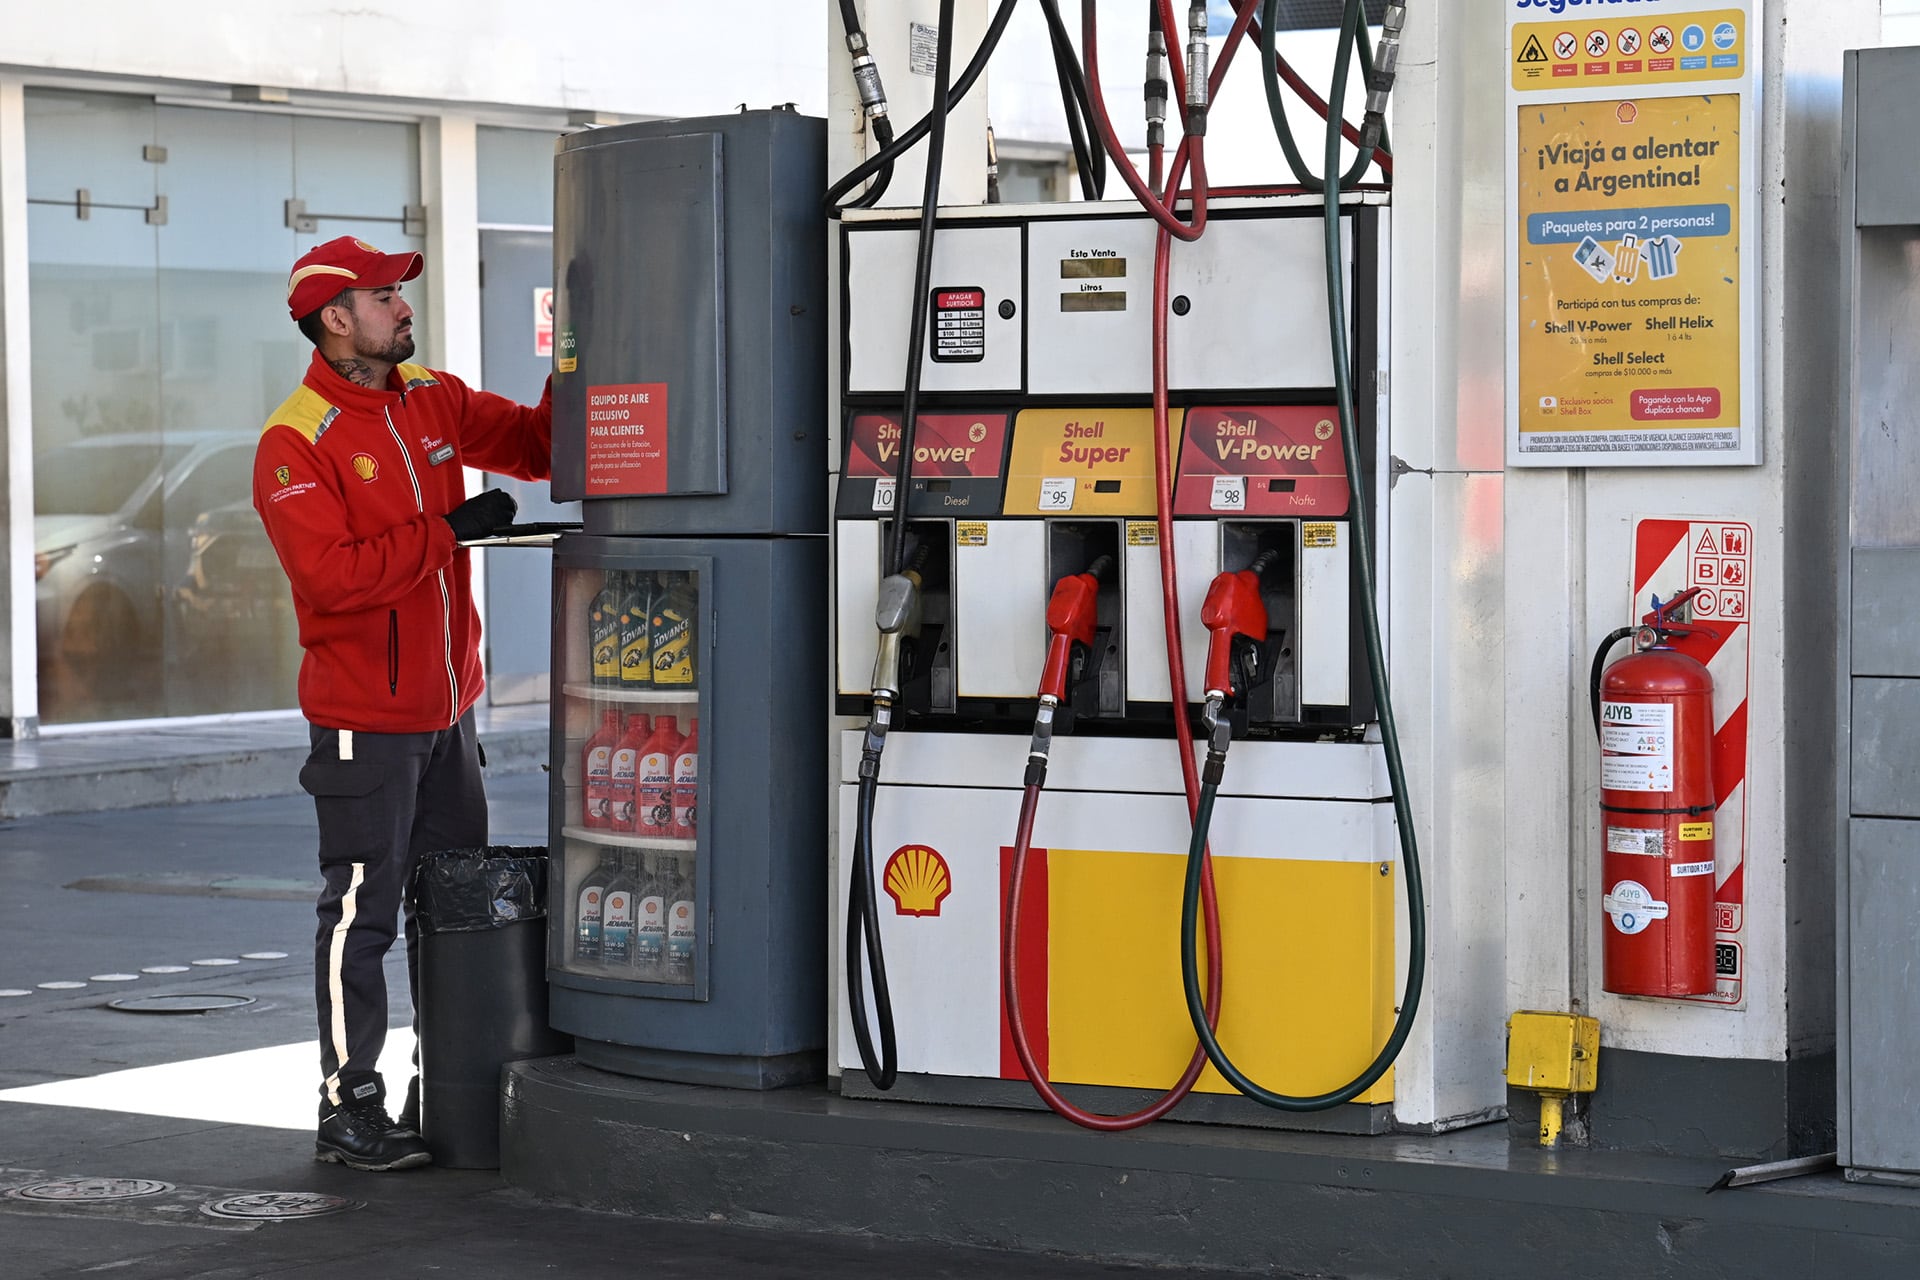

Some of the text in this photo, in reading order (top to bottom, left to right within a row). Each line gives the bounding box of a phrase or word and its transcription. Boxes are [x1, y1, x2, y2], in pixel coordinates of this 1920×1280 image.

[1538, 137, 1720, 170] ¡Viajá a alentar
[1554, 164, 1700, 196] a Argentina!
[1542, 213, 1715, 238] ¡Paquetes para 2 personas!
[1071, 249, 1116, 258] Esta Venta
[1080, 283, 1102, 291] Litros
[1557, 294, 1701, 311] Participá con tus compras de:
[1545, 320, 1632, 334] Shell V-Power
[1645, 316, 1714, 330] Shell Helix
[1593, 352, 1665, 365] Shell Select
[1585, 370, 1612, 378] compras
[1624, 368, 1651, 376] $10.000
[591, 393, 648, 405] EQUIPO DE AIRE
[1560, 397, 1613, 405] Exclusivo socios
[1639, 395, 1672, 405] Pagando
[1696, 394, 1712, 404] App
[591, 410, 630, 421] EXCLUSIVO
[1560, 407, 1592, 416] Shell Box
[1644, 405, 1704, 416] duplicás chances
[591, 425, 644, 436] PARA CLIENTES
[878, 424, 902, 439] She
[1064, 422, 1104, 439] Shell
[1216, 420, 1256, 437] Shell
[877, 442, 975, 462] V-ower
[1059, 441, 1130, 468] Super
[1216, 439, 1322, 461] V-Power
[944, 496, 970, 506] Diesel
[1053, 491, 1067, 504] 95
[1224, 490, 1239, 503] 98
[1289, 495, 1316, 505] Nafta
[1699, 564, 1714, 578] B
[1697, 594, 1711, 610] C
[654, 618, 689, 648] ADVANCE
[1604, 705, 1632, 720] AJYB
[1677, 865, 1700, 874] SURTIDOR
[1619, 889, 1640, 898] AJYB
